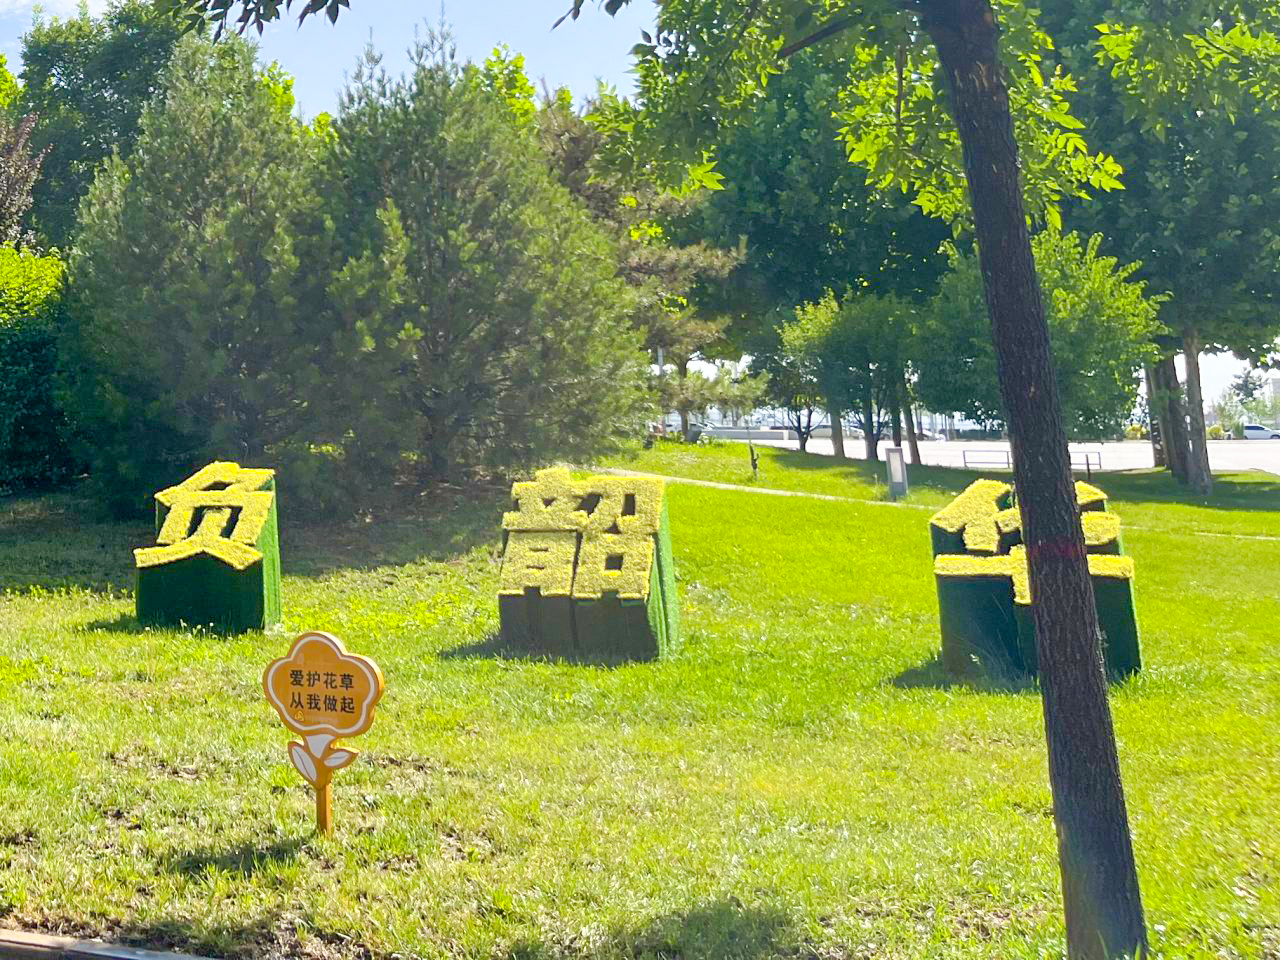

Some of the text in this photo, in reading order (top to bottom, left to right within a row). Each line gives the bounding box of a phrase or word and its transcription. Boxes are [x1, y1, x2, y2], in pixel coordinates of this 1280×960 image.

[133, 461, 276, 571] 负
[290, 670, 354, 690] 爱护花草
[290, 692, 355, 714] 从我做起
